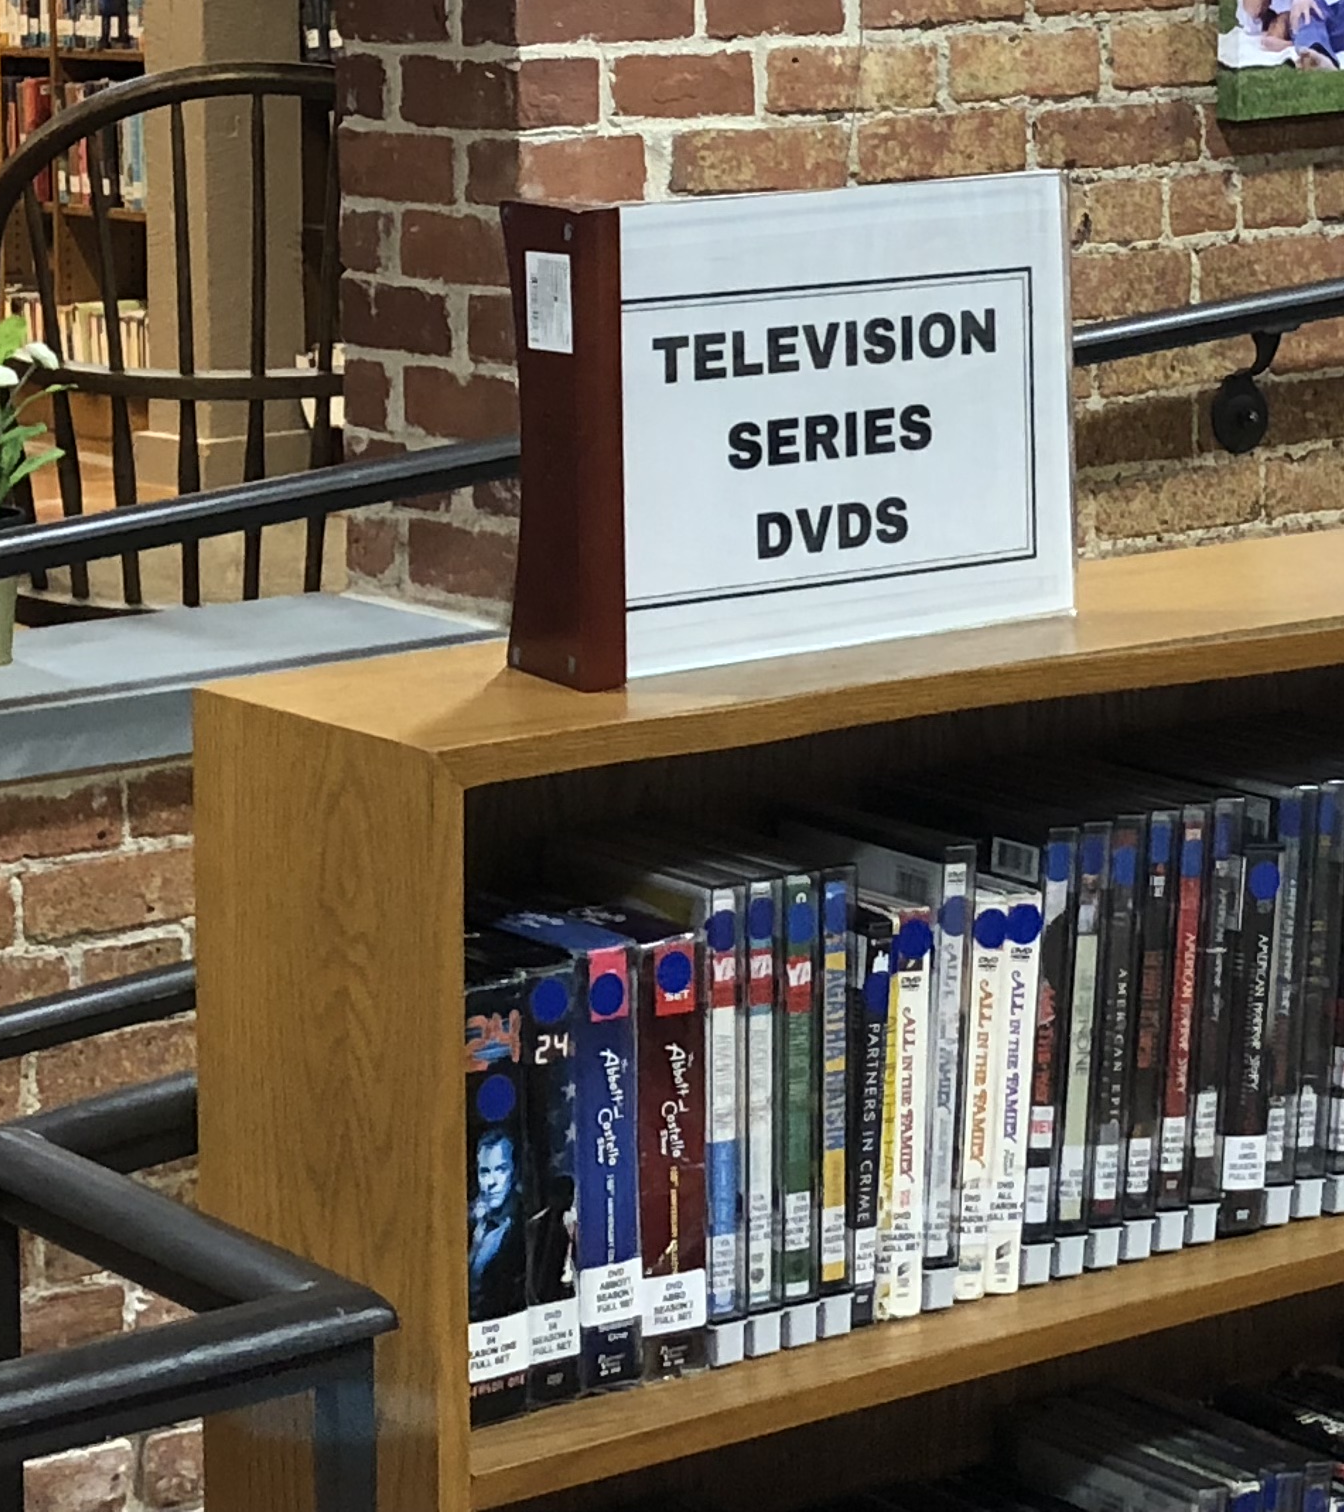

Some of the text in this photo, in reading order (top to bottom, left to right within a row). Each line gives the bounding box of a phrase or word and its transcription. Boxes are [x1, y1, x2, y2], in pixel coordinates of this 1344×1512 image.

[652, 308, 996, 384] TELEVISION
[727, 404, 933, 472] SERIES
[756, 496, 909, 561] DVDS
[1011, 970, 1026, 1016] ALL
[1181, 934, 1197, 999] AMERICAN
[1254, 934, 1269, 997] AMERICAN
[902, 1007, 917, 1053] ALL
[978, 979, 994, 1028] ALL
[1113, 968, 1128, 1072] AMERICAN
[464, 1010, 522, 1073] 24
[534, 1032, 570, 1065] 24
[665, 1043, 689, 1098] Abbott
[974, 1032, 989, 1084] IN THE
[1007, 1018, 1022, 1073] IN THE
[599, 1049, 625, 1104] Abbott
[863, 1023, 882, 1122] PARTNERS
[901, 1056, 913, 1107] IN THE
[598, 1108, 620, 1166] Costello
[661, 1101, 685, 1159] Costello
[970, 1089, 988, 1169] FAMILY
[1003, 1072, 1020, 1144] FAMILY
[862, 1131, 874, 1151] IN
[900, 1108, 915, 1183] FAMILY
[855, 1162, 873, 1223] CRIME
